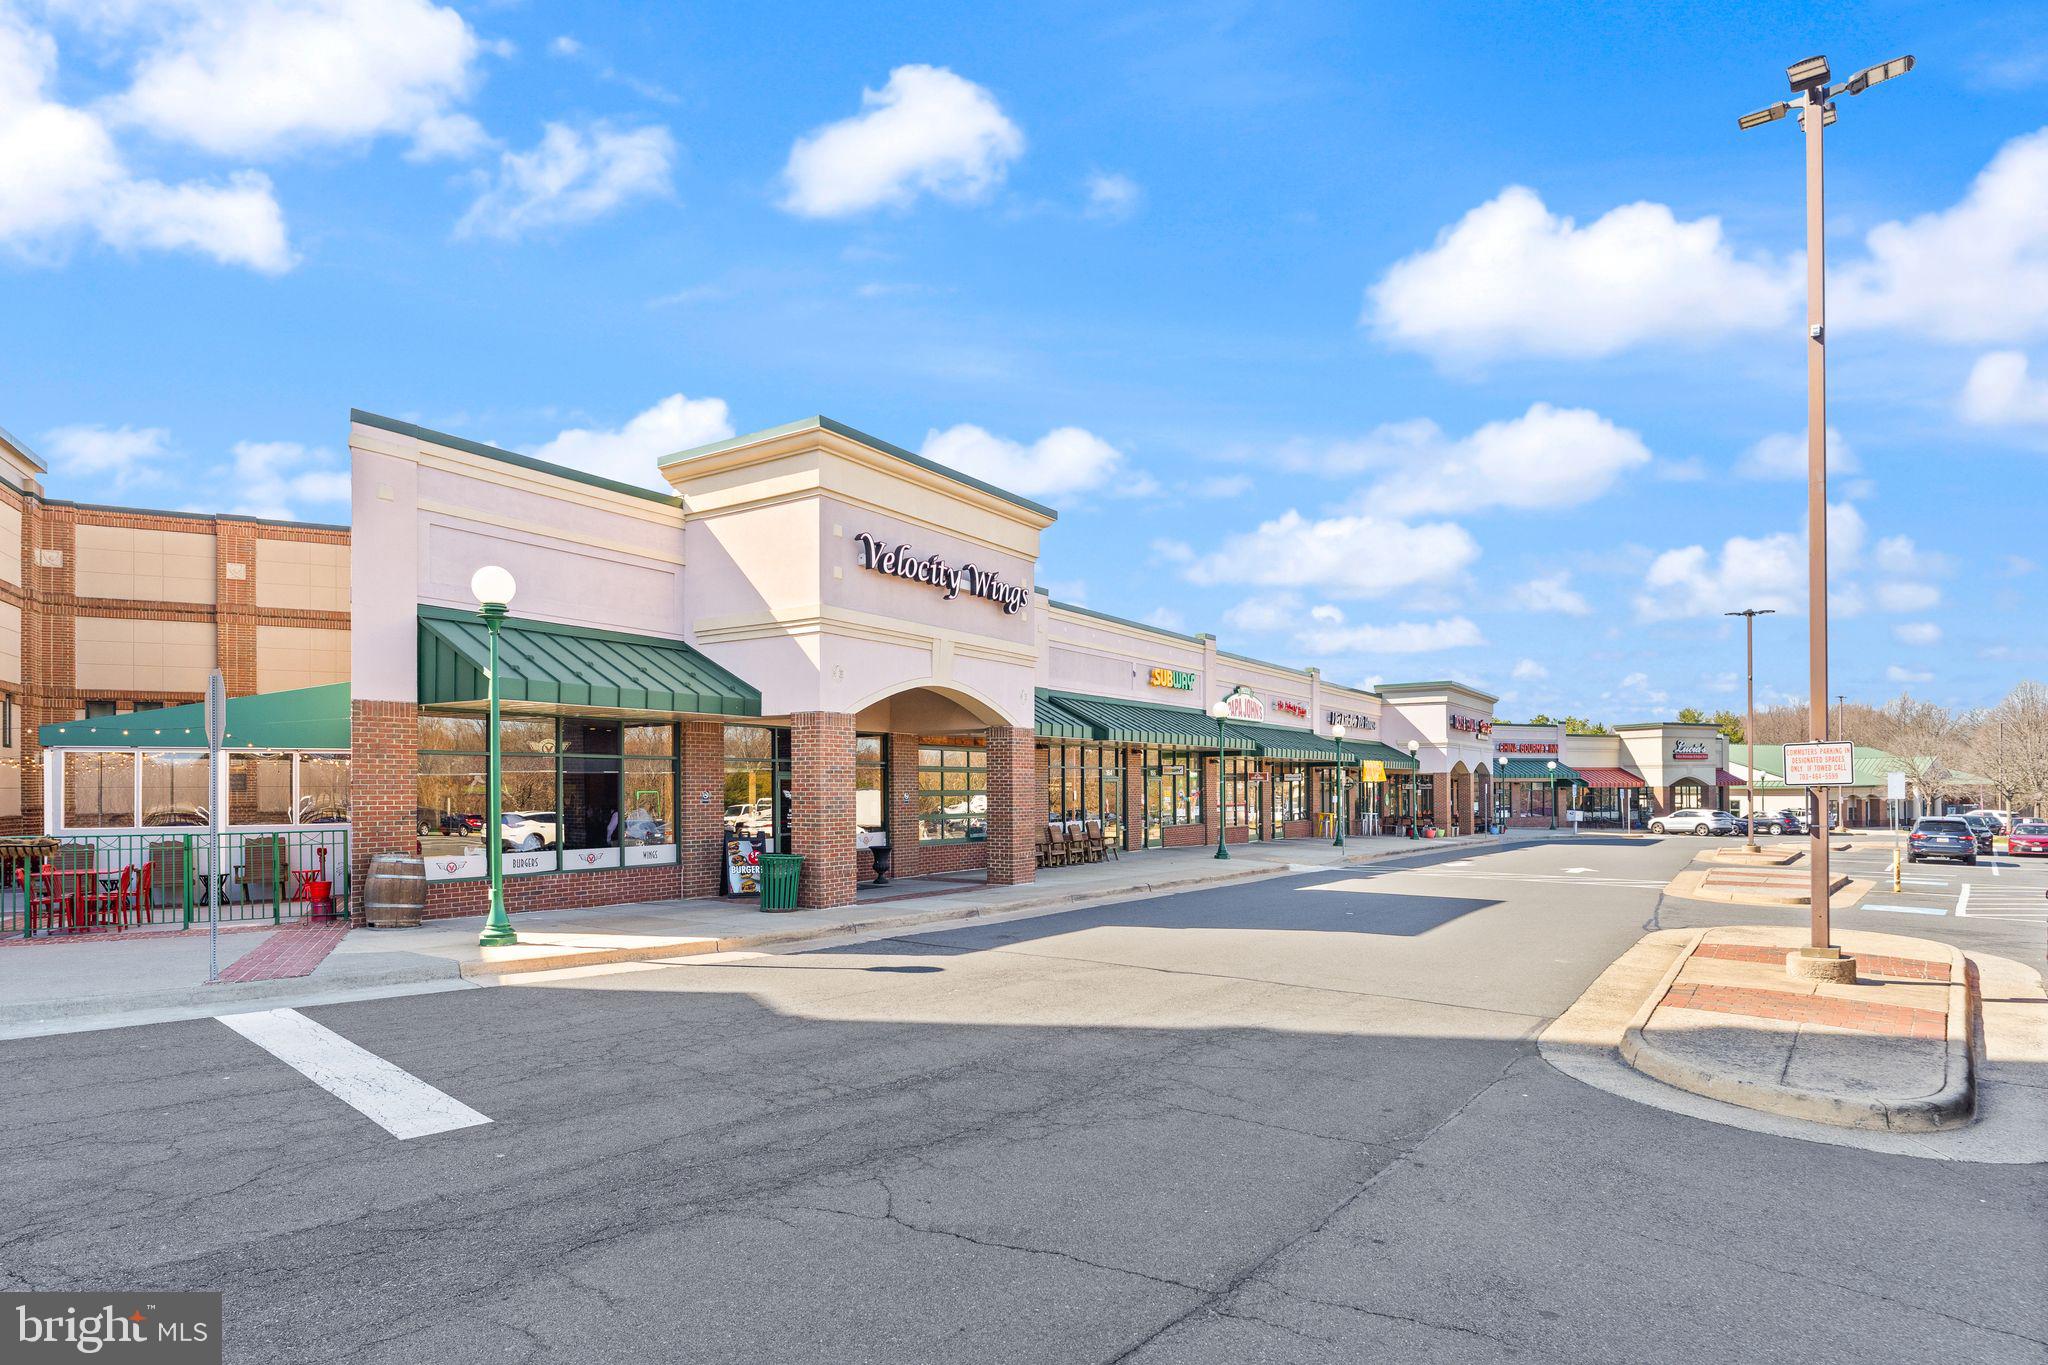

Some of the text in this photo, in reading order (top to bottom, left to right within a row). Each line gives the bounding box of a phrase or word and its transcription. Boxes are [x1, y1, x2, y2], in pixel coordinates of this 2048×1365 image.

[856, 532, 1029, 614] Velocity Wings
[1151, 668, 1196, 690] SUBWAY
[512, 857, 539, 868] BURGERS
[643, 850, 658, 859] WINGS
